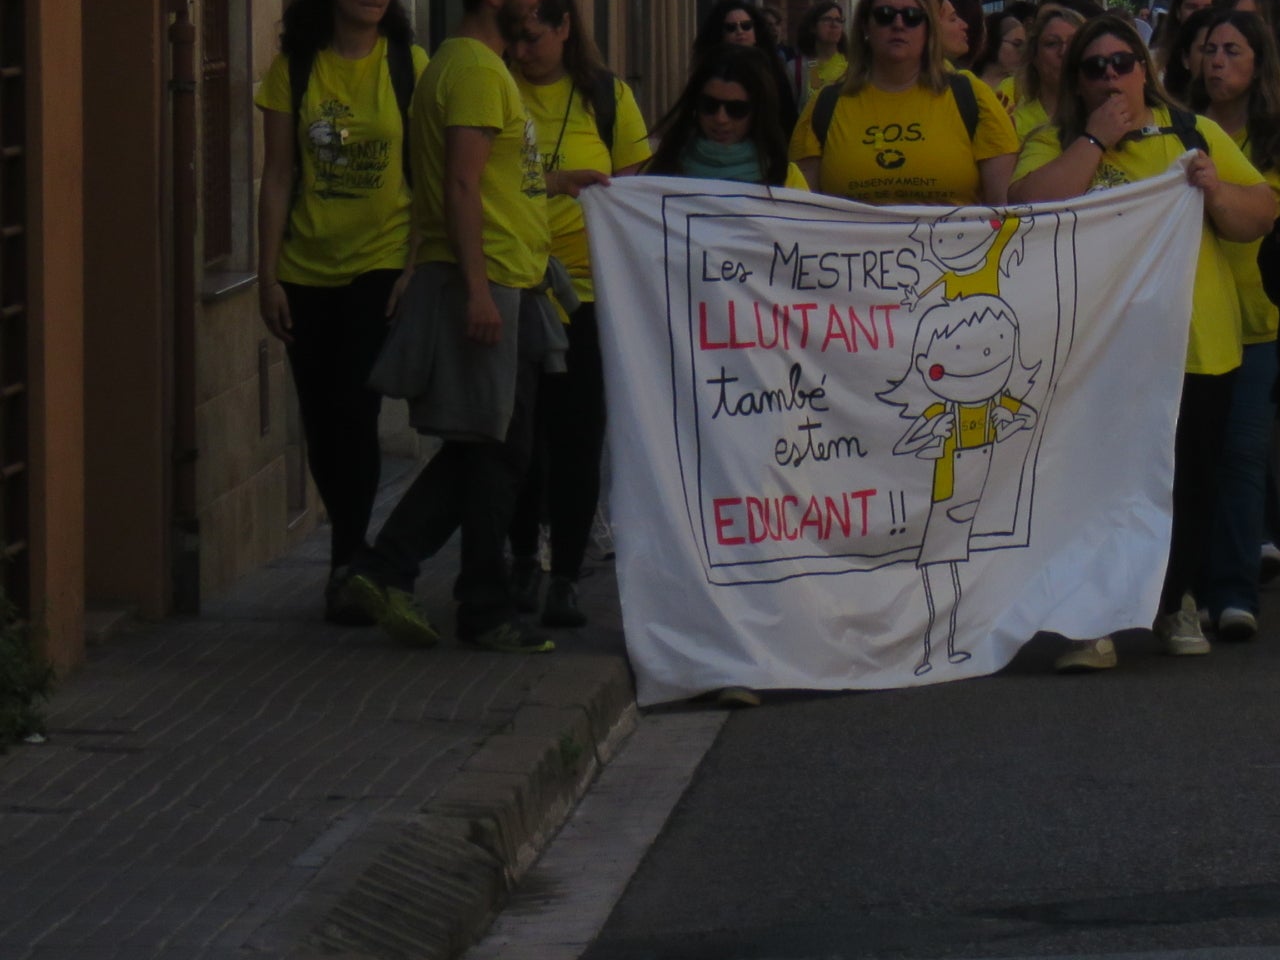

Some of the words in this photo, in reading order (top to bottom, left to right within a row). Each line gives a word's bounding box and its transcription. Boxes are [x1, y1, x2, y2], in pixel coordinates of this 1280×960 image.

[702, 250, 753, 283] Les
[769, 242, 921, 291] MESTRES
[699, 300, 901, 353] LLUITANT
[706, 363, 830, 419] també
[775, 416, 868, 468] estem
[713, 489, 878, 545] EDUCANT
